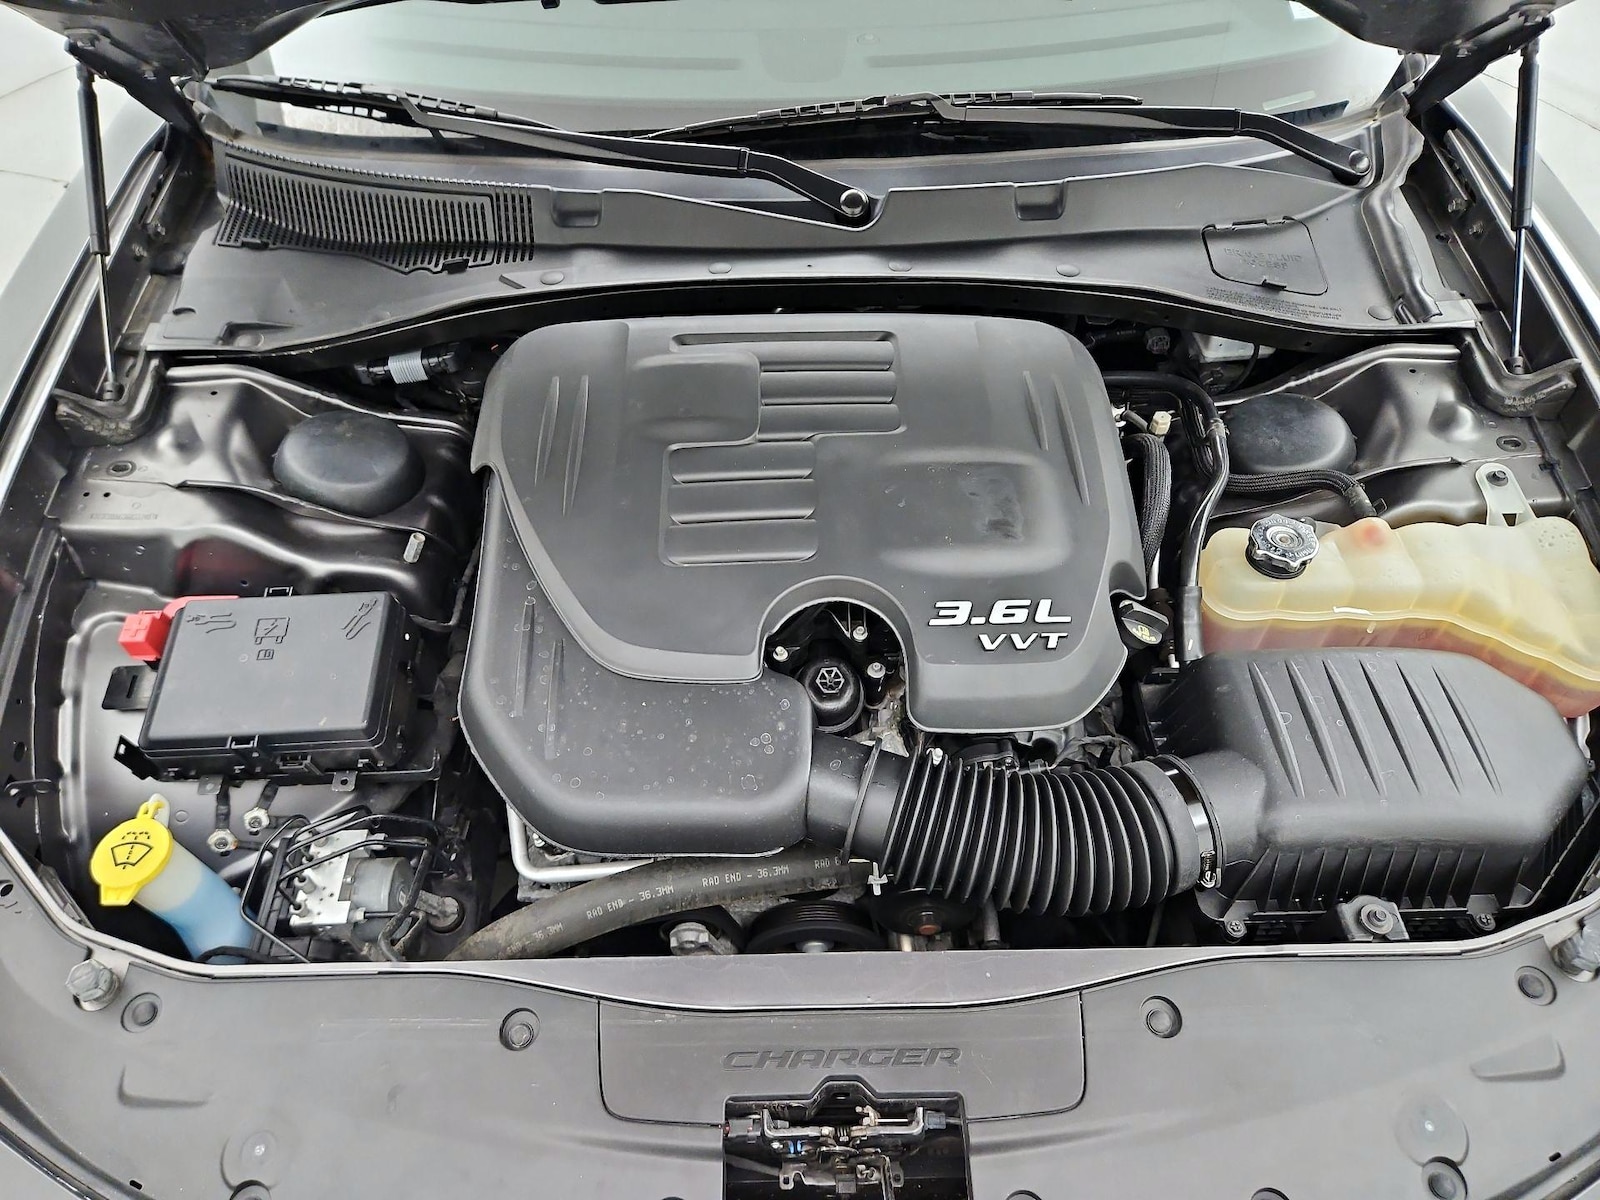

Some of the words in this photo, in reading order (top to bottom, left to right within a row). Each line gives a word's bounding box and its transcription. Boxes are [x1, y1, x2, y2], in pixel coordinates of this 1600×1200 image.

[928, 598, 1072, 626] 3.6L
[978, 632, 1069, 651] VVT
[702, 876, 720, 888] RAD
[725, 872, 742, 884] END
[757, 864, 790, 879] 36.3MM
[814, 859, 830, 870] RAD
[586, 905, 604, 920] RAD
[607, 898, 624, 912] END
[638, 885, 674, 901] 36.3MM
[533, 922, 564, 940] 36.3MM
[722, 1047, 962, 1071] CHARGER
